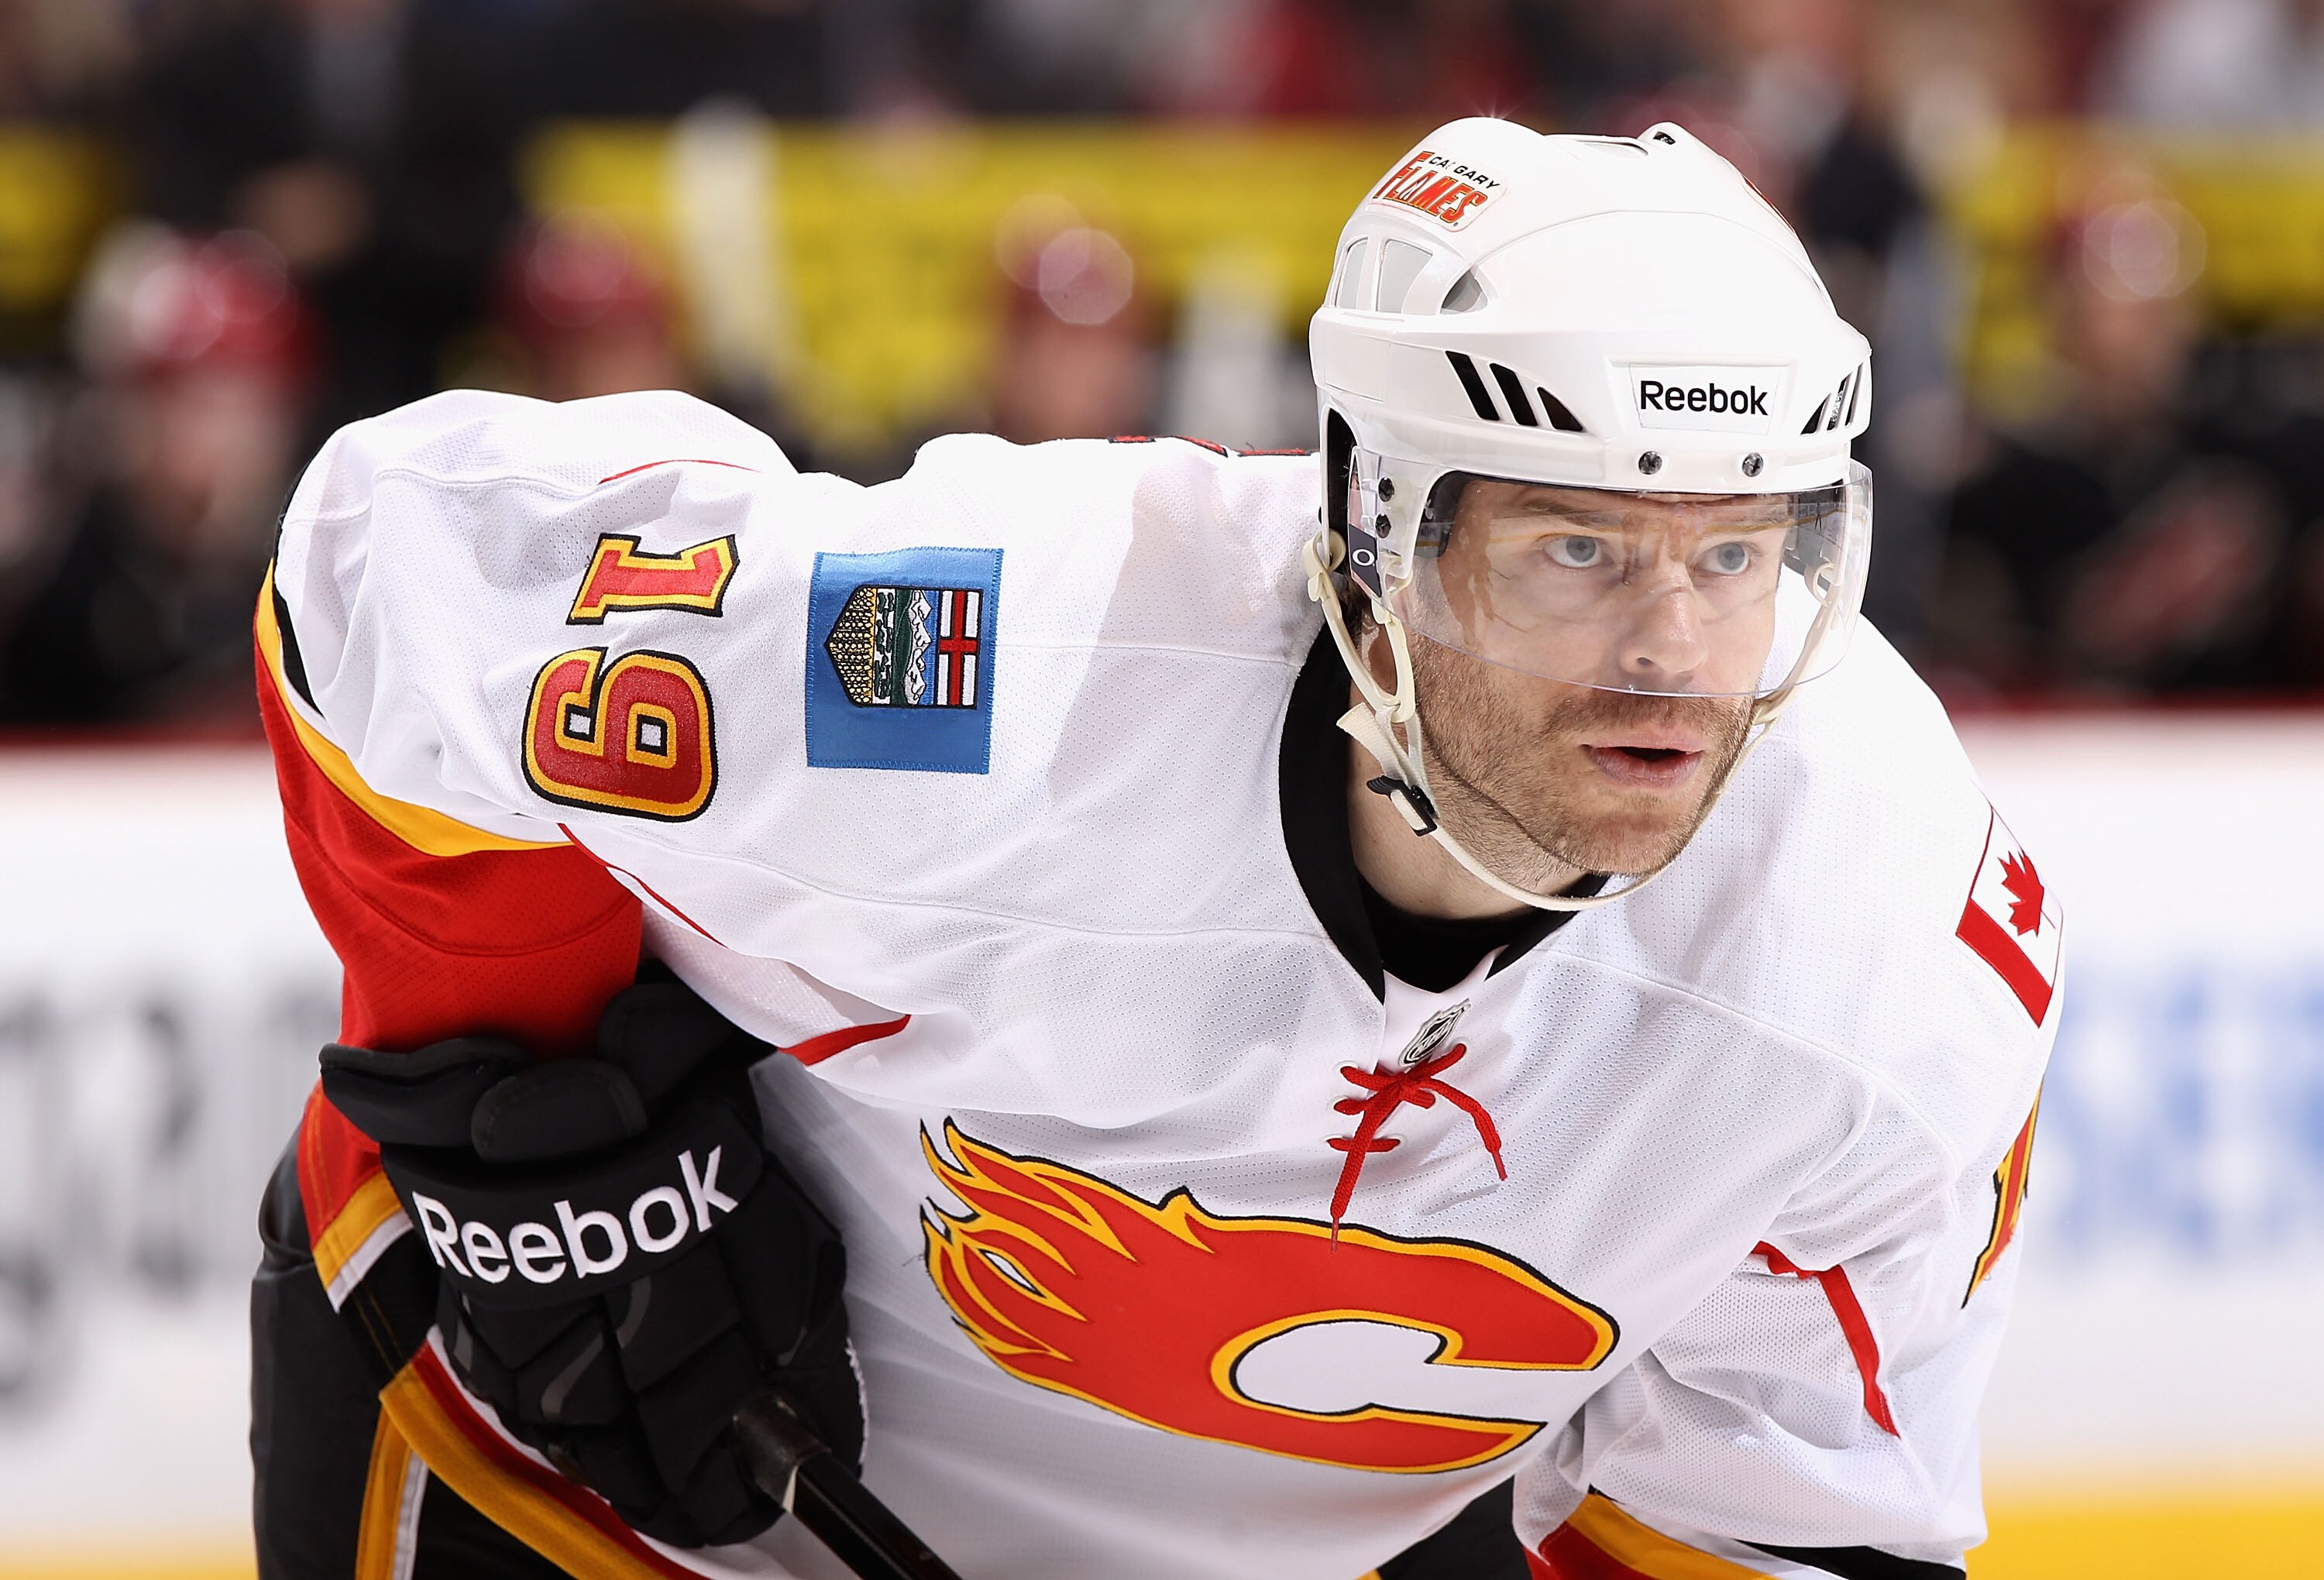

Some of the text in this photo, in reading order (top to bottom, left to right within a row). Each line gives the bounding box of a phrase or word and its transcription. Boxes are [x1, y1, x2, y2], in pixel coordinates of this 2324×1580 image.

[1372, 150, 1488, 223] FLAMES
[1640, 380, 1769, 416] Reebok
[411, 1146, 738, 1283] Reebok
